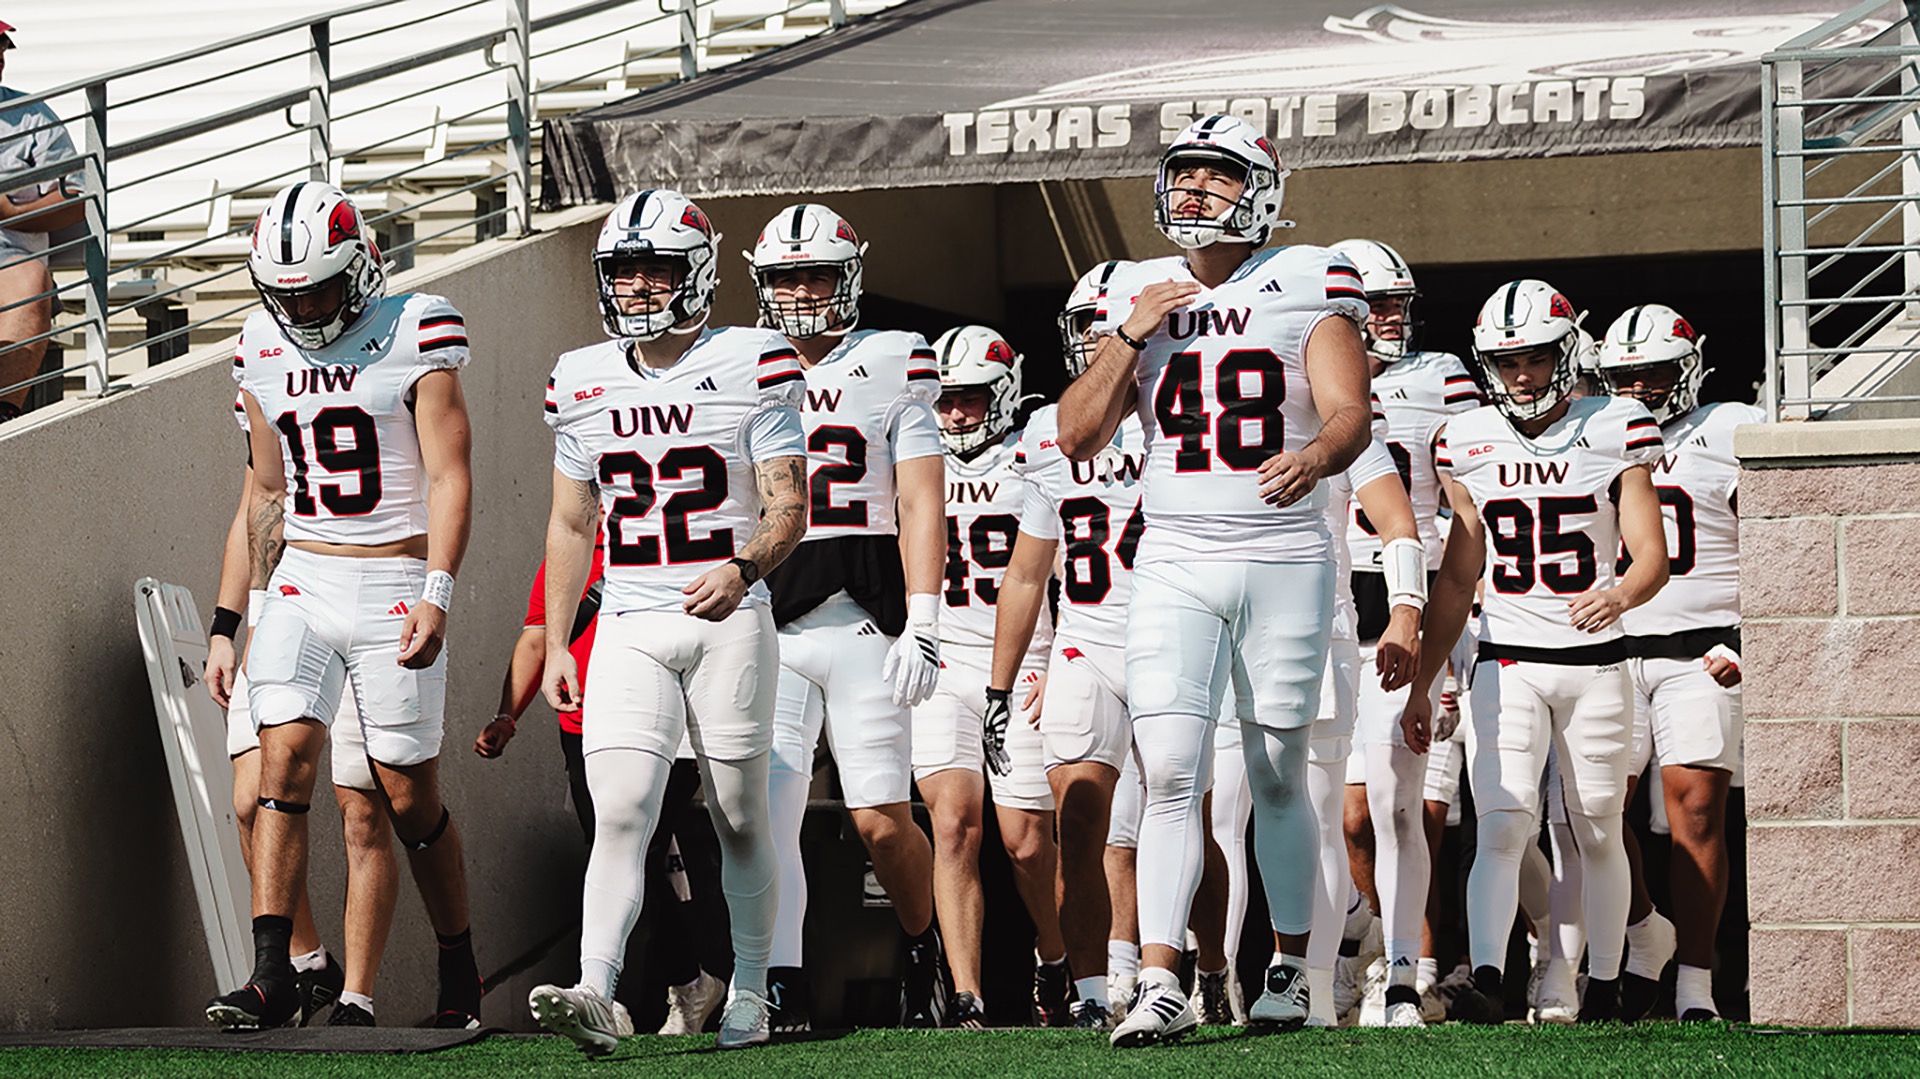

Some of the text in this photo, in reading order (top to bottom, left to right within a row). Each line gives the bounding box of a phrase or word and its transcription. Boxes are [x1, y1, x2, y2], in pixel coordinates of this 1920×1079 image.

[944, 104, 1131, 155] TEXAS
[1368, 76, 1646, 134] BOBCATS
[1168, 307, 1252, 340] UIW
[286, 365, 358, 397] UIW
[574, 387, 605, 401] SLC
[609, 404, 693, 438] UIW
[1155, 348, 1286, 473] 48
[276, 406, 382, 516] 19
[1040, 440, 1058, 450] SL
[1498, 462, 1569, 487] UIW
[598, 445, 735, 567] 22
[1615, 485, 1696, 577] 0
[1482, 494, 1598, 594] 95
